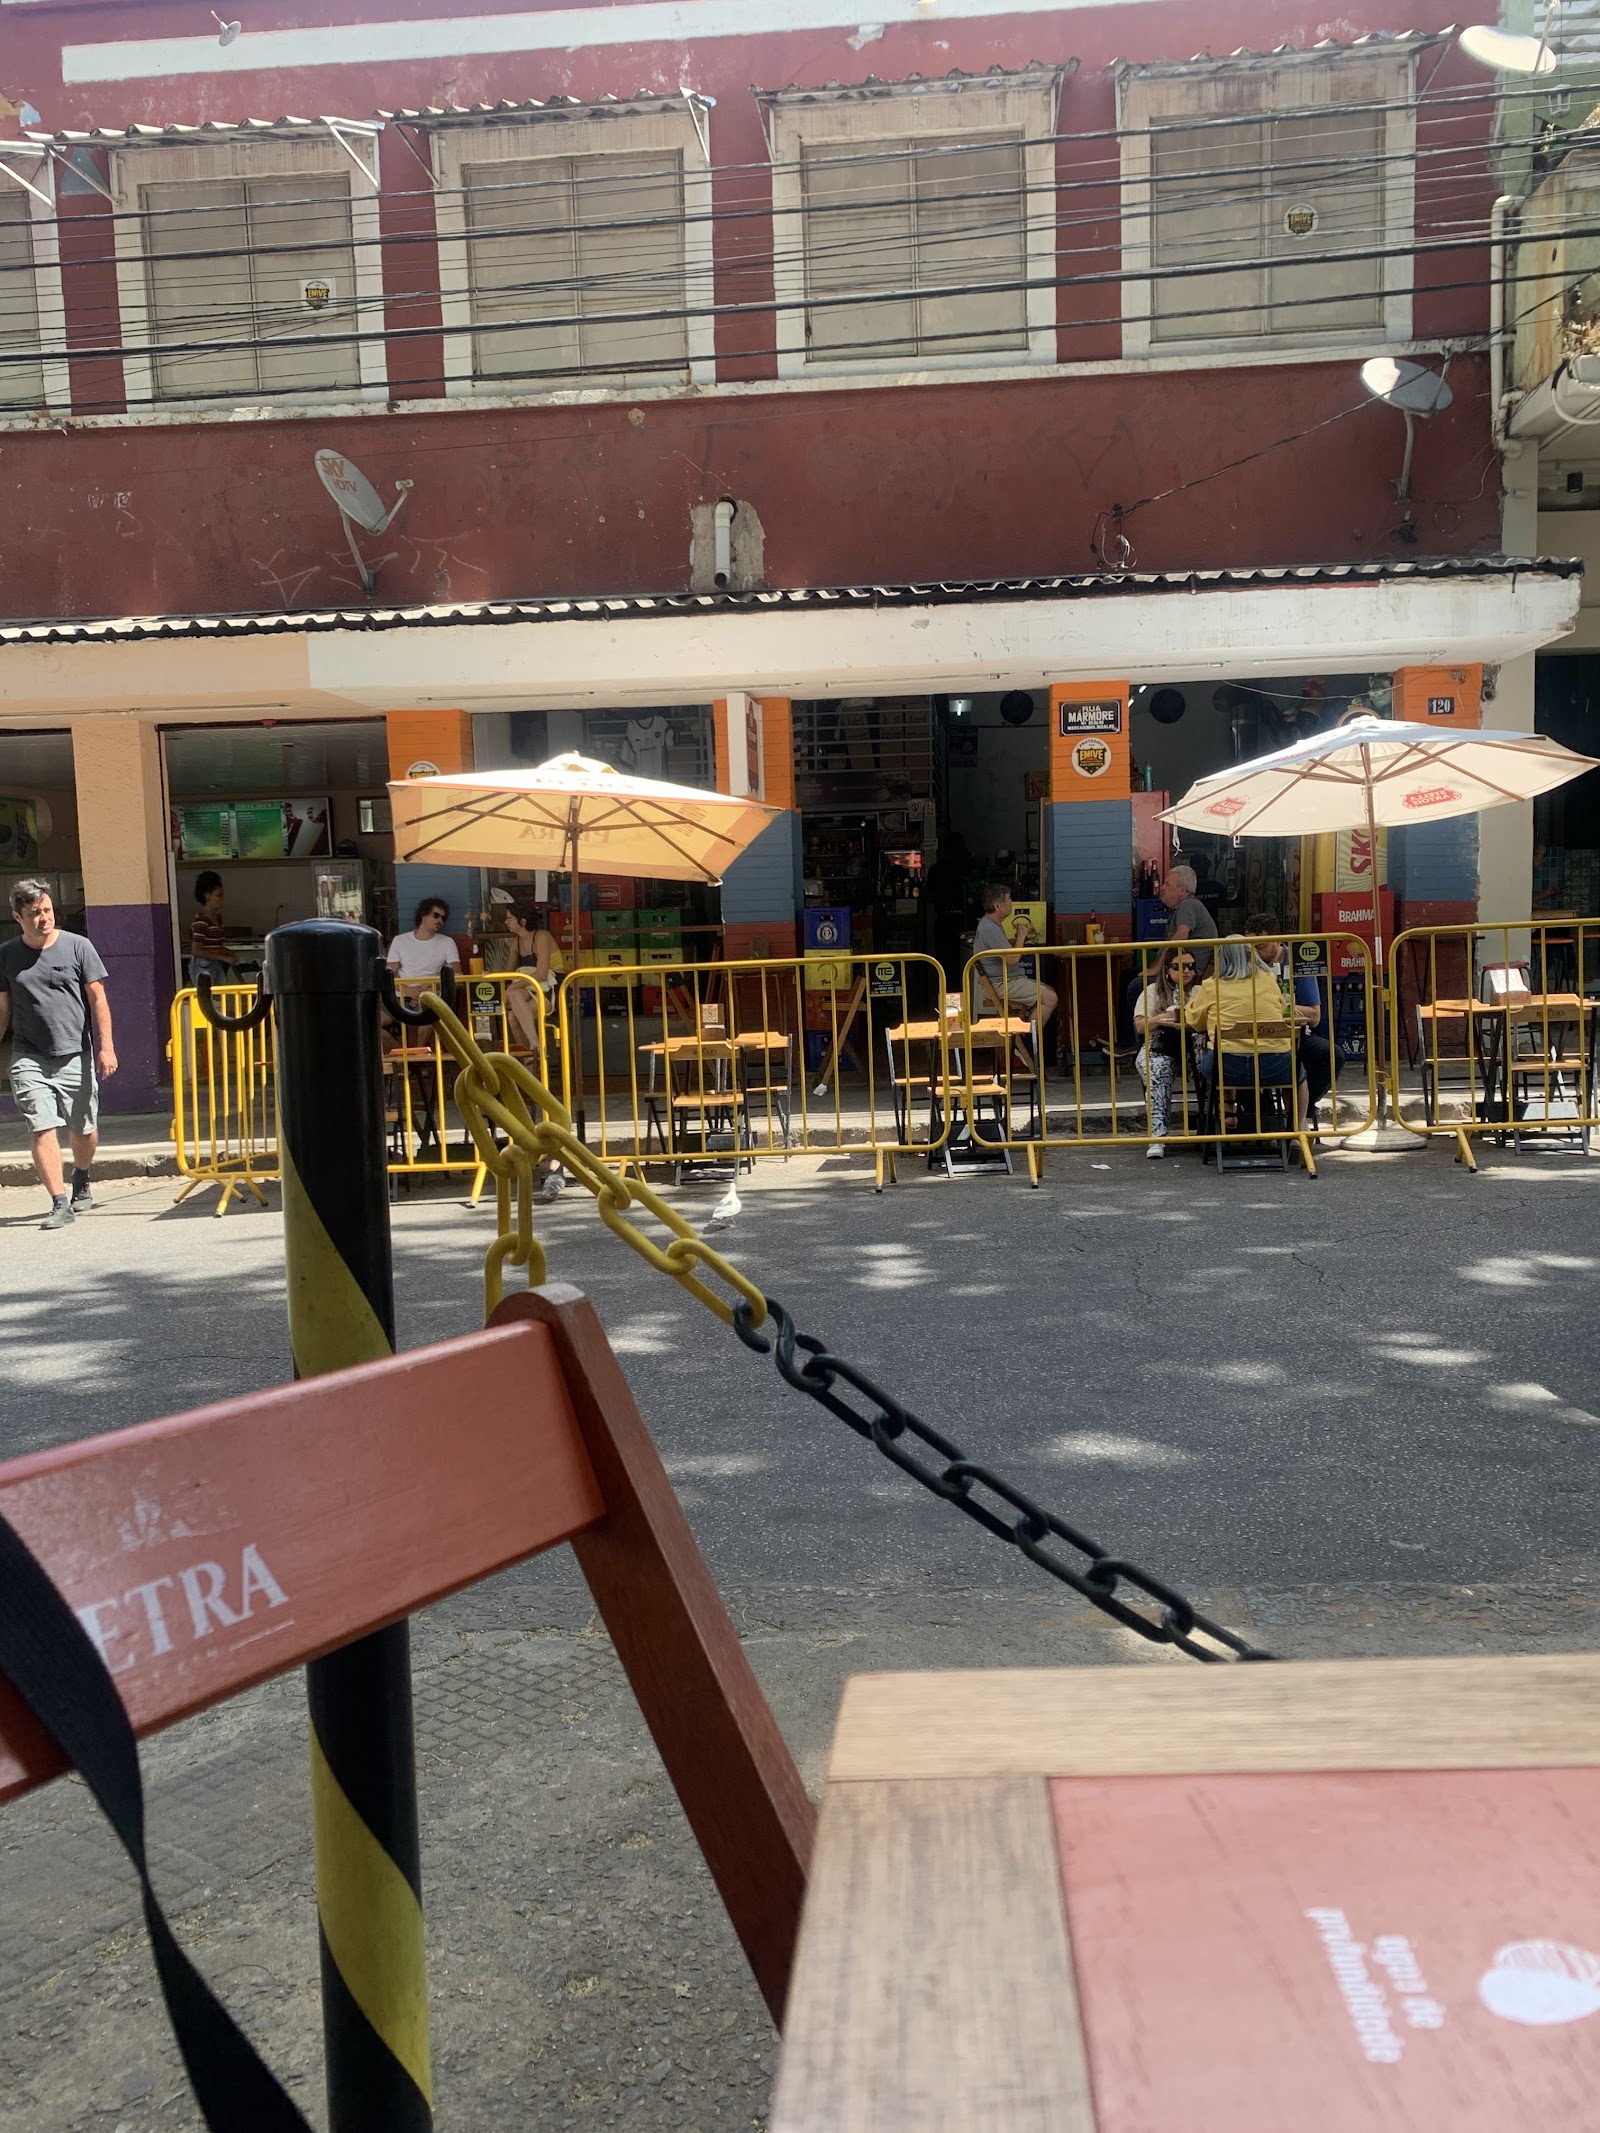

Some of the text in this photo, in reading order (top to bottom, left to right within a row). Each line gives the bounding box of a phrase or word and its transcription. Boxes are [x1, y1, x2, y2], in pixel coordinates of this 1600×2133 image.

[320, 456, 345, 478] SKY
[1082, 705, 1101, 713] RUA
[1432, 699, 1450, 714] 120
[1068, 710, 1114, 723] MÁRMORE
[1080, 750, 1103, 760] EMIVE
[1150, 917, 1168, 925] ambe
[75, 1542, 290, 1676] ETRA
